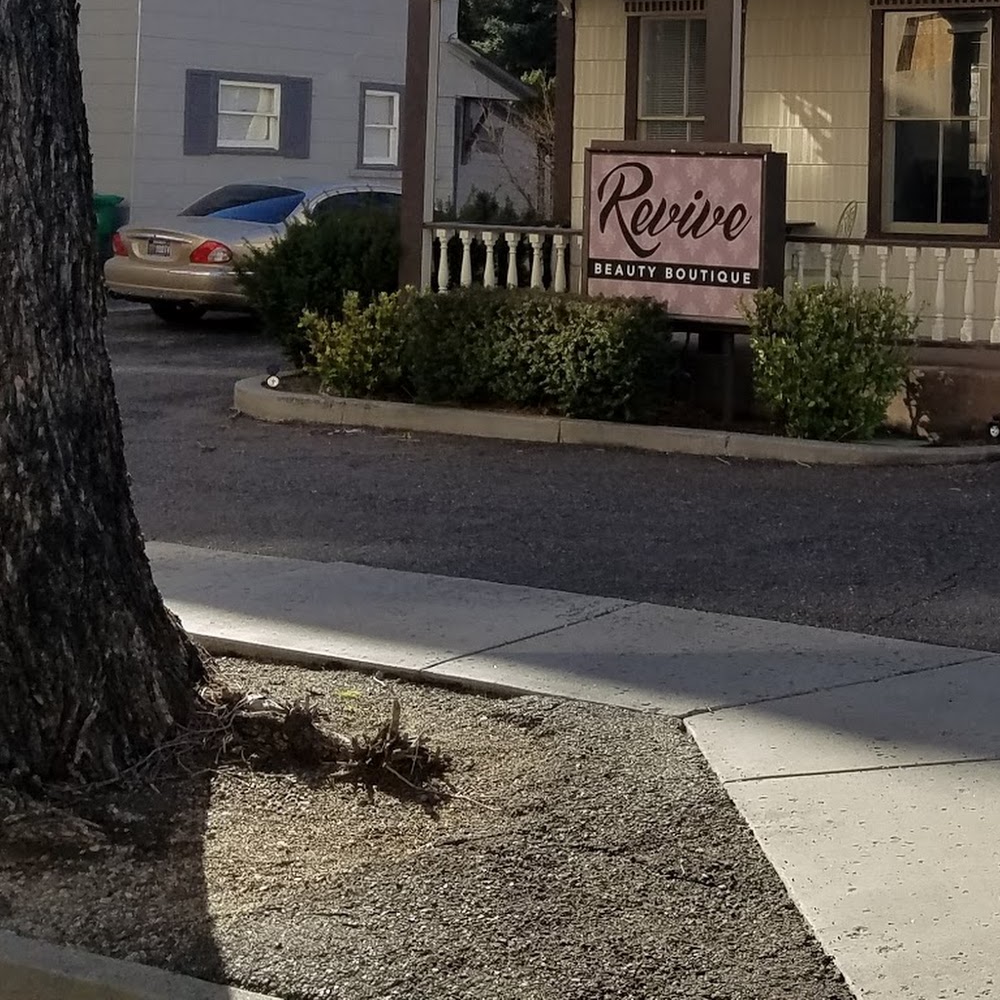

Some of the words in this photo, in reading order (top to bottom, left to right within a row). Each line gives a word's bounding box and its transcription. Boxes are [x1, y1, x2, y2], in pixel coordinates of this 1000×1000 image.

[597, 162, 752, 258] Revive
[594, 262, 657, 279] BEAUTY
[665, 267, 751, 285] BOUTIQUE
